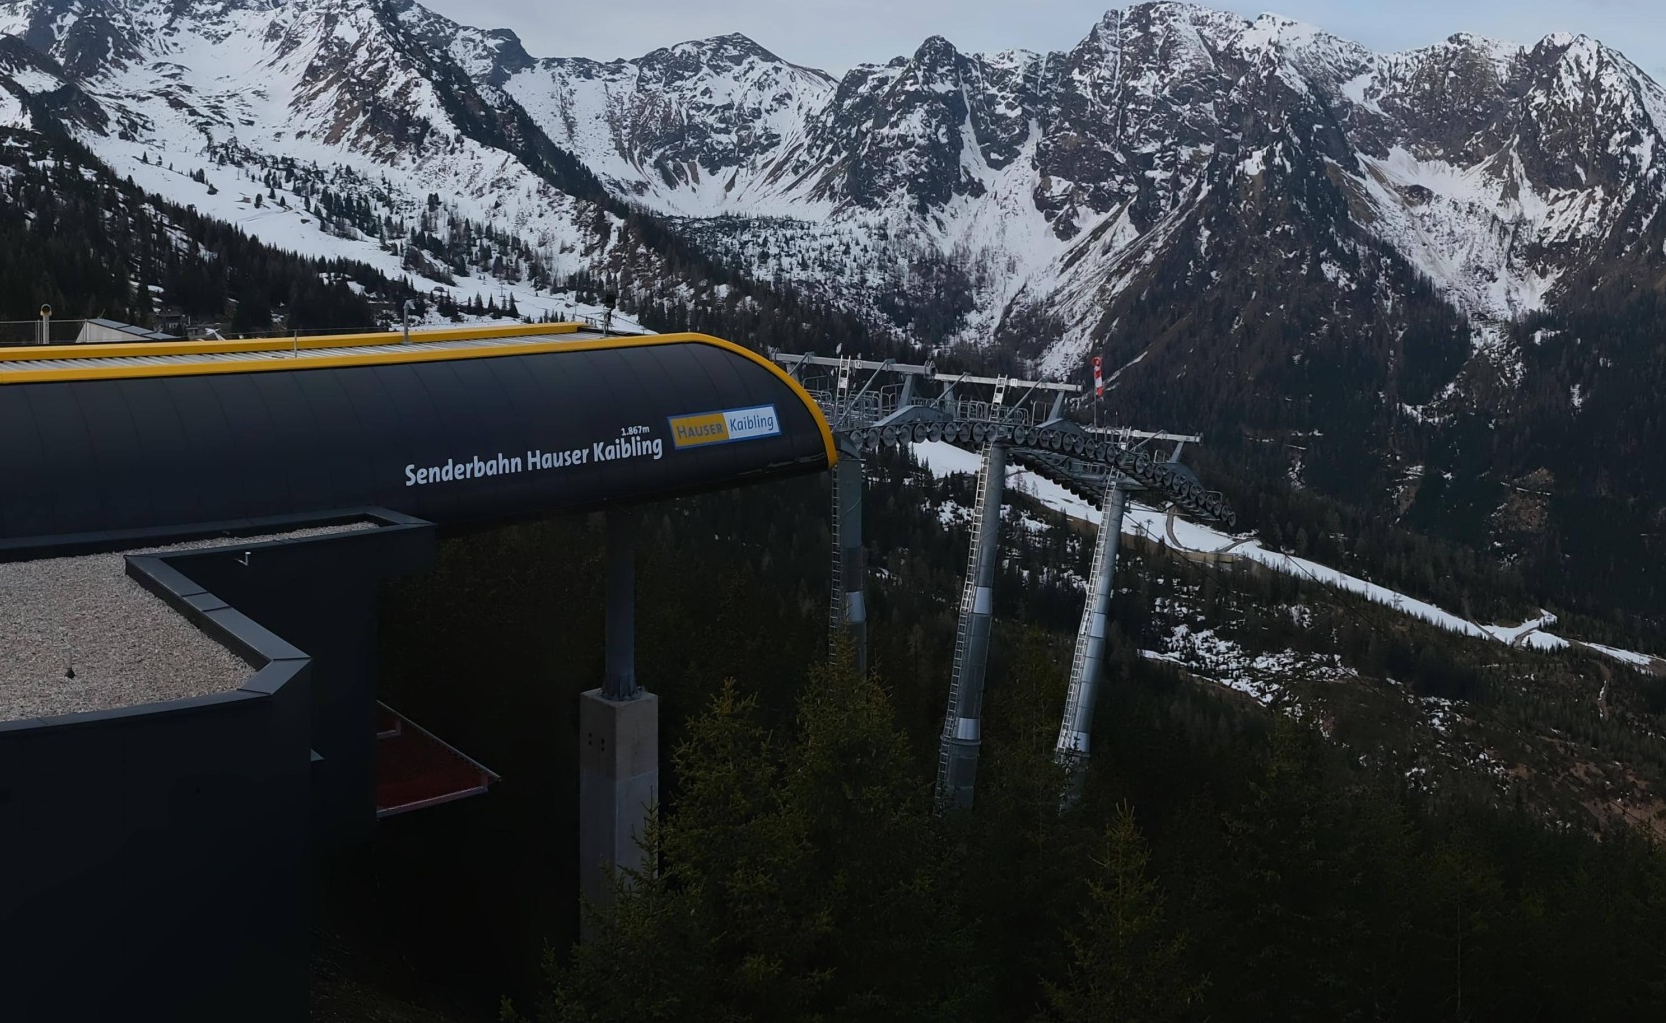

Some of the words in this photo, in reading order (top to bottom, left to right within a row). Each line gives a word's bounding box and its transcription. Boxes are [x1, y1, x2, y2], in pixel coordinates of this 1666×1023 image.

[621, 424, 650, 436] 1.867m
[676, 423, 724, 439] HAUSER
[729, 415, 774, 432] Kaibling
[405, 452, 522, 486] Senderbahn
[527, 447, 589, 471] Hauser
[593, 435, 663, 460] Kaibling
